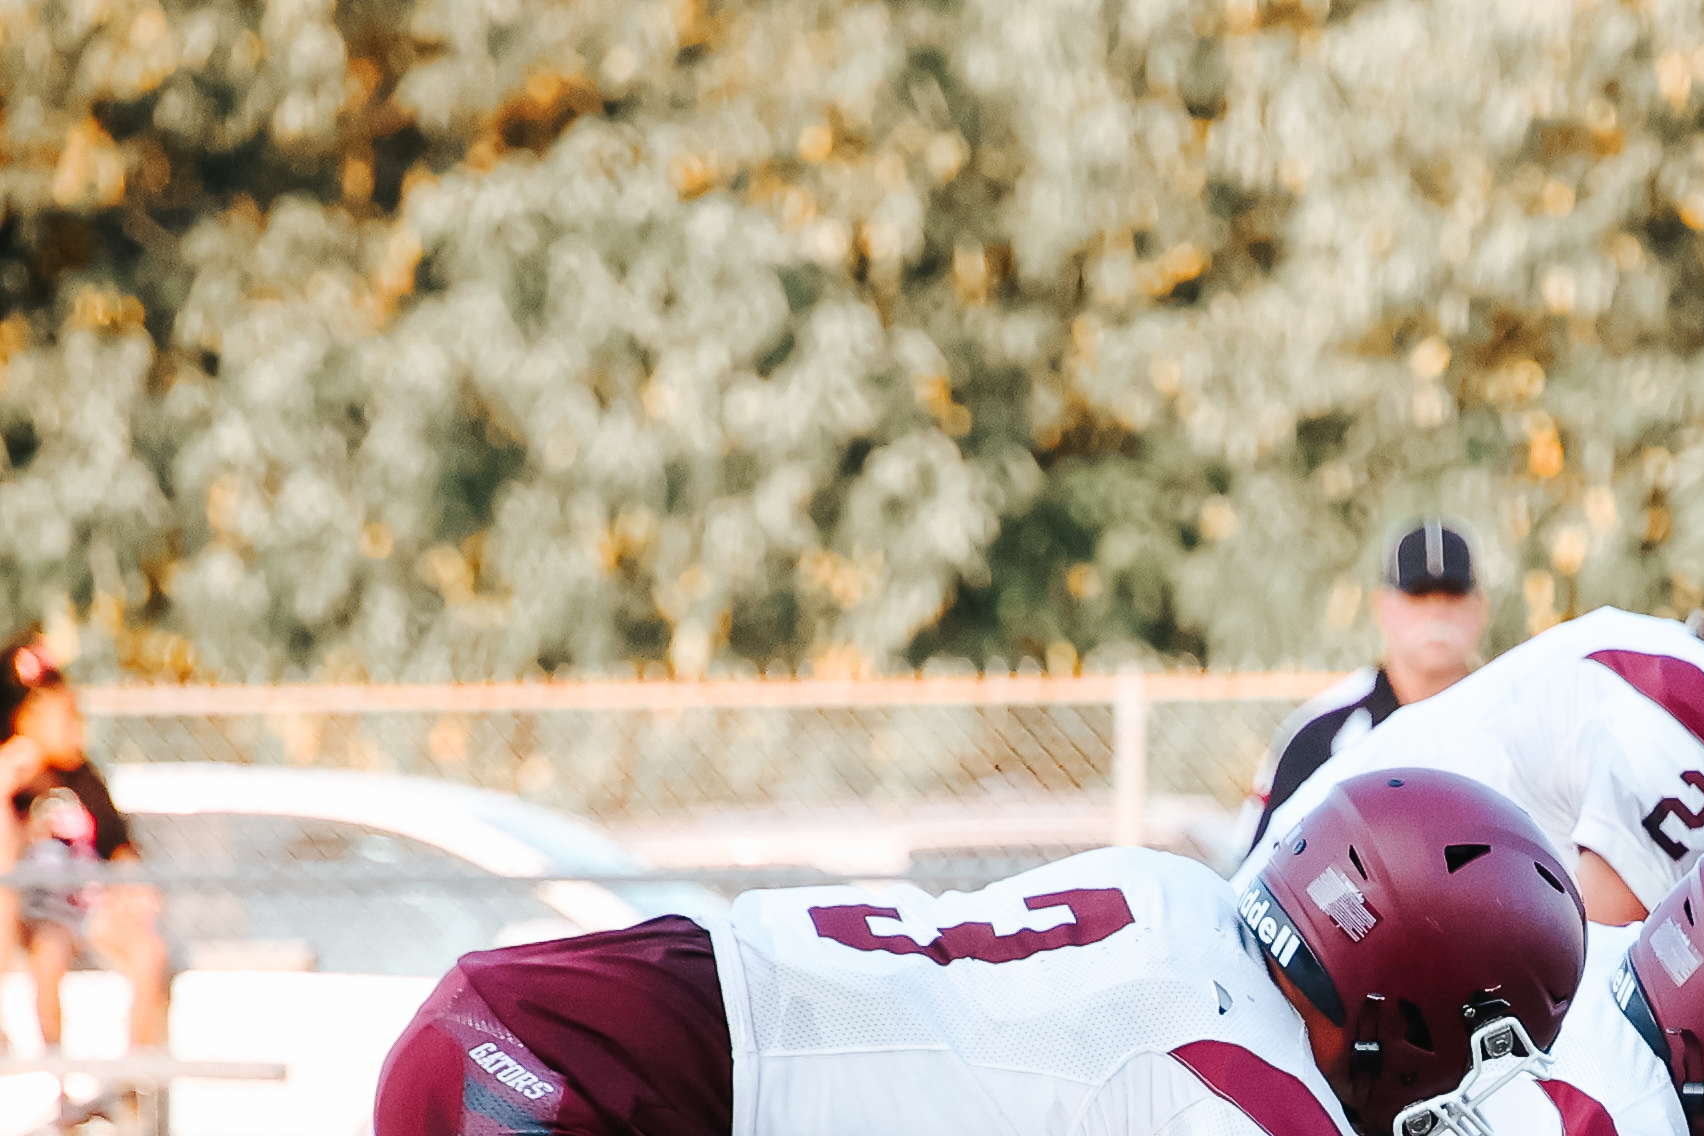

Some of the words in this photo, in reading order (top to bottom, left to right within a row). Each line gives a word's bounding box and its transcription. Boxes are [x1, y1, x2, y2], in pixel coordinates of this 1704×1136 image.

[808, 888, 1135, 966] 3
[1239, 886, 1301, 968] ddell
[467, 1041, 555, 1100] GATORS
